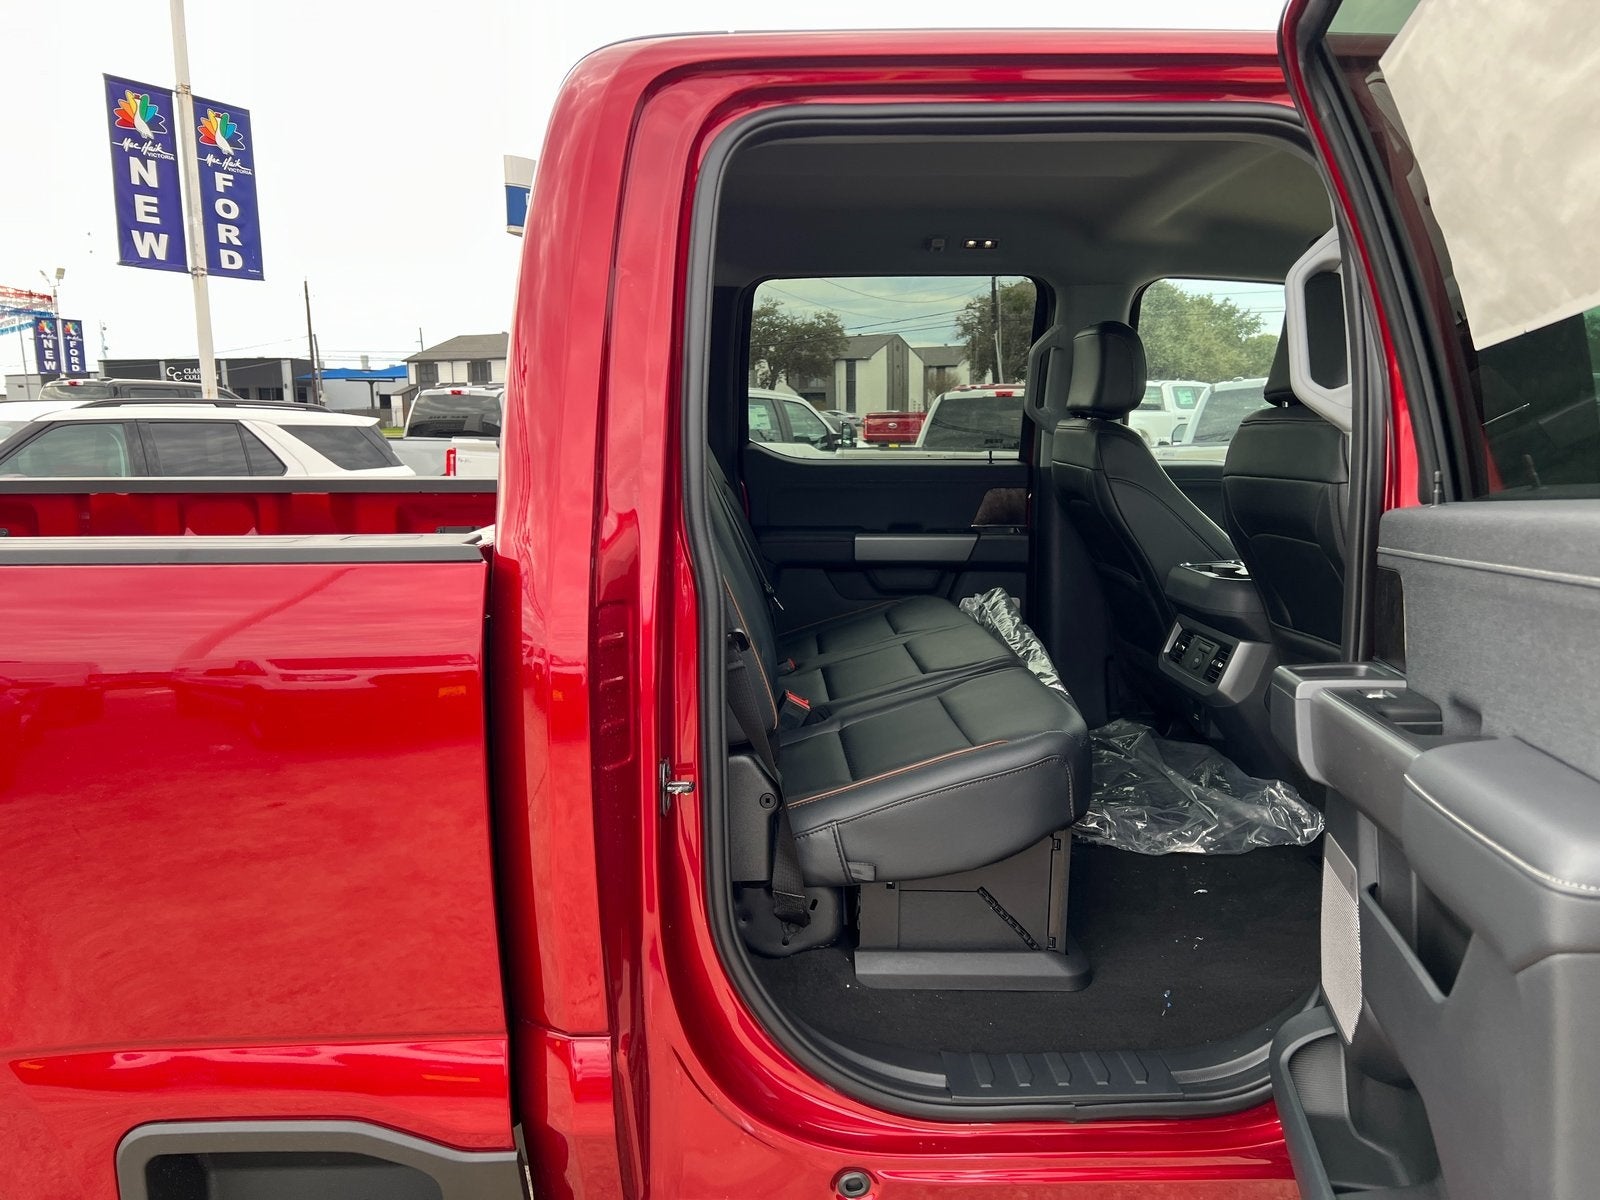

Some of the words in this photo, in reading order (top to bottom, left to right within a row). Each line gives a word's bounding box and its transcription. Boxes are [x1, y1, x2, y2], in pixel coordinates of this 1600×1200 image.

[147, 152, 175, 161] VICTORIA
[227, 167, 253, 175] VICTORIA
[128, 156, 169, 261] NEW
[214, 171, 243, 270] FORD
[42, 339, 56, 370] NEW
[69, 341, 81, 372] FORD
